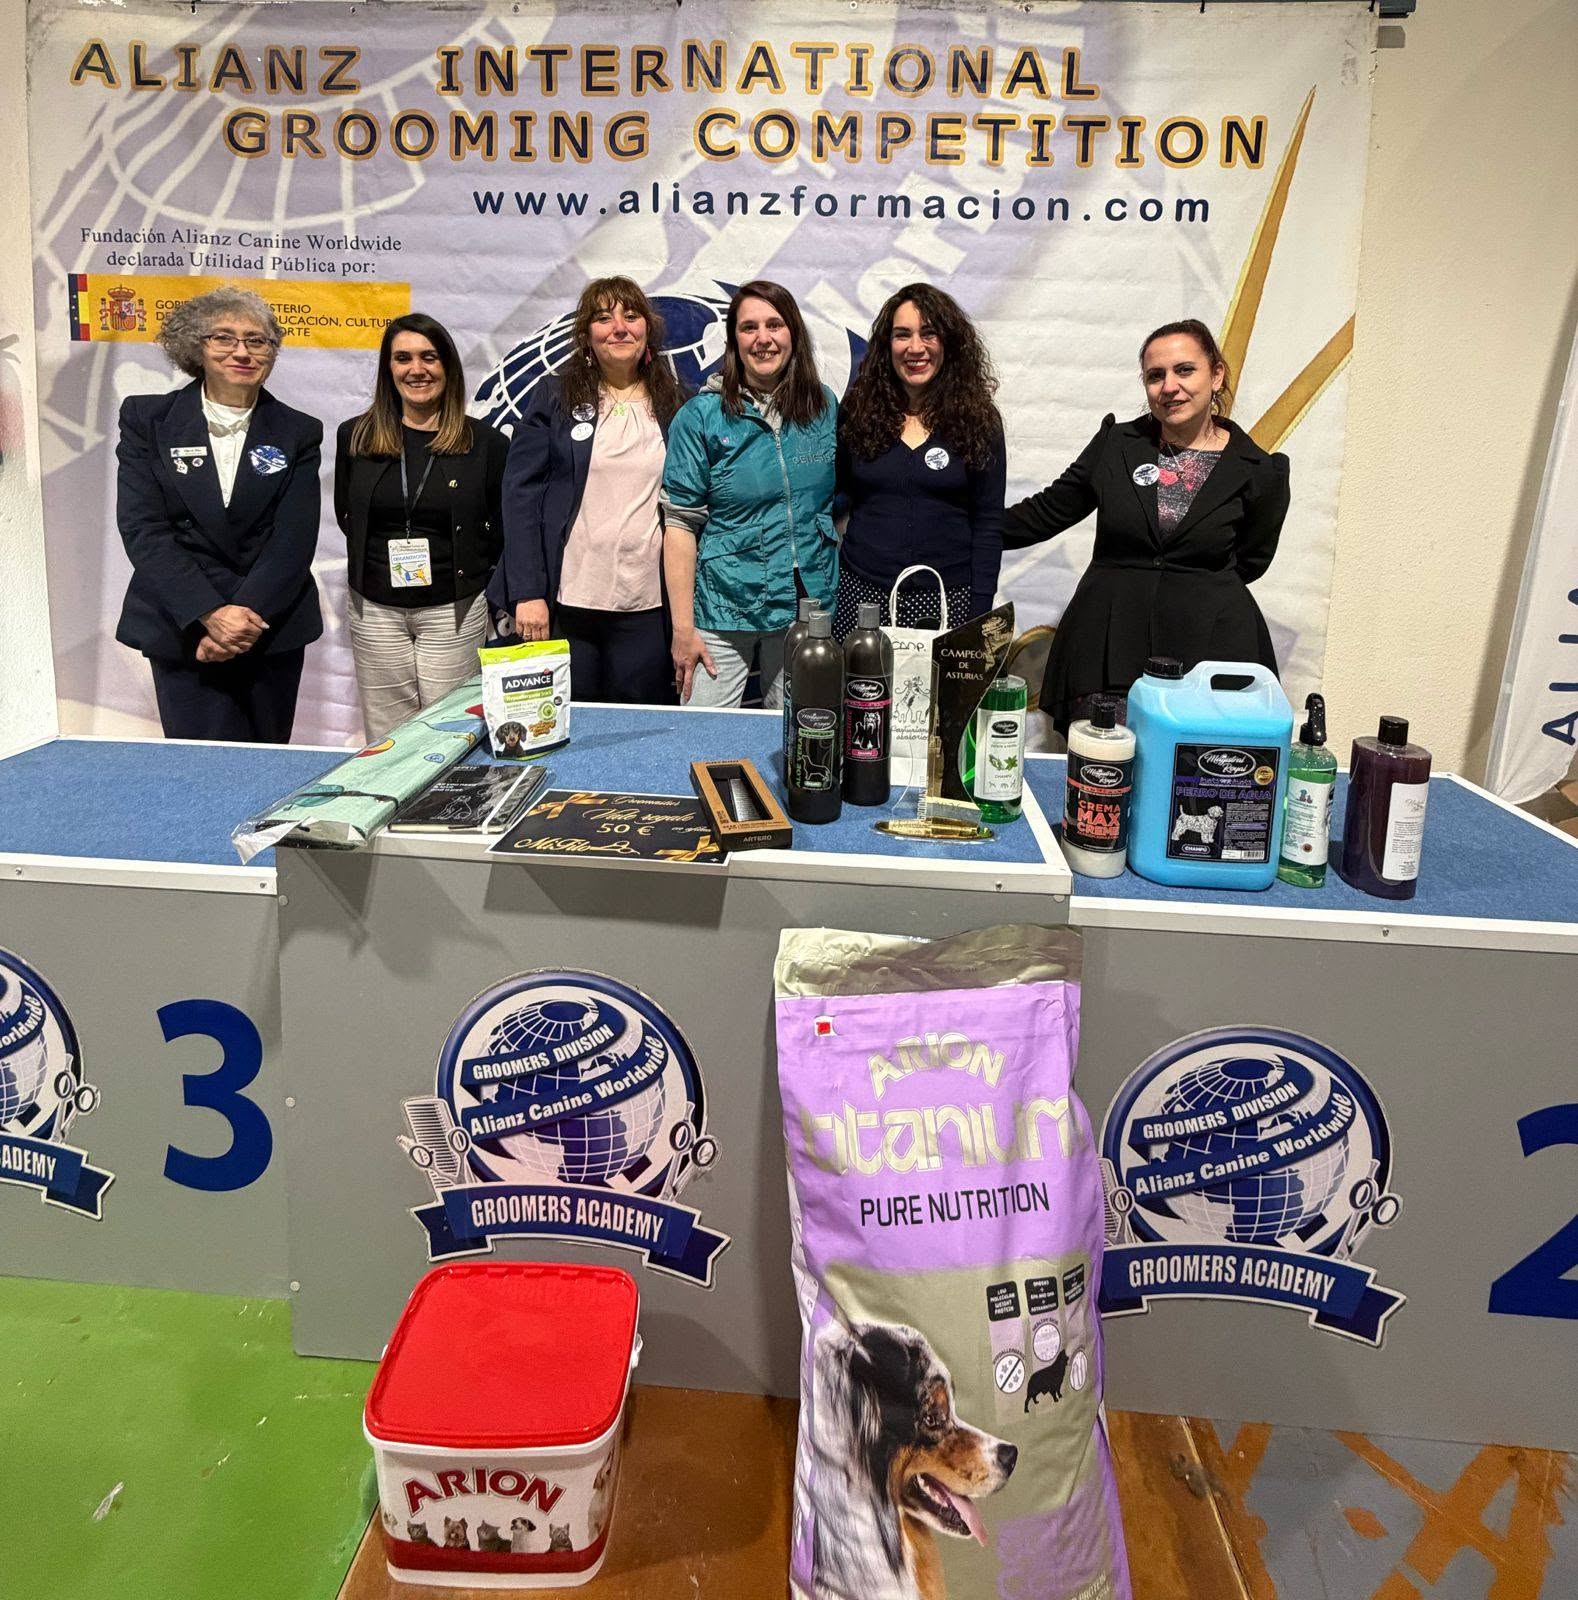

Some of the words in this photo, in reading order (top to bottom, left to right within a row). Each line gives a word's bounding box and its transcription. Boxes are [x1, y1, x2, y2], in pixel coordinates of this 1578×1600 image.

[71, 38, 361, 95] ALIANZ
[438, 39, 1100, 102] INTERNATIONAL
[223, 107, 650, 163] GROOMING
[692, 107, 1269, 169] COMPETITION
[472, 183, 1211, 224] www.alianzformacion.com
[81, 228, 166, 244] Fundación
[171, 229, 231, 247] Alianz
[238, 233, 301, 250] Canine
[305, 234, 402, 252] Worldwide
[106, 252, 185, 267] declarada
[190, 252, 265, 271] Utilidad
[271, 256, 337, 274] Pública
[341, 261, 377, 276] por:
[266, 303, 311, 314] STERIO
[345, 317, 392, 328] CULTUR
[505, 675, 551, 690] ADVANCE
[945, 671, 984, 681] ASTURIAS
[958, 661, 970, 669] DE
[1222, 762, 1248, 775] Royal
[1079, 799, 1121, 812] CREMA
[1176, 786, 1218, 798] PERRO
[1219, 788, 1237, 800] DE
[1238, 789, 1272, 800] AGUA
[596, 822, 630, 834] 50
[637, 825, 655, 836] €
[1077, 807, 1121, 827] MAX
[743, 834, 772, 843] ARTERO
[0, 994, 43, 1049] orldwide
[472, 1051, 551, 1081] GROOMERS
[553, 1022, 616, 1062] DIVISION
[867, 1032, 1007, 1101] ARION
[156, 998, 273, 1192] 3
[470, 1111, 527, 1138] Alianz
[528, 1092, 593, 1122] Canine
[594, 1034, 665, 1100] Worldwide
[1143, 1110, 1227, 1140] GROOMERS
[1231, 1081, 1300, 1121] DIVISION
[0, 1143, 57, 1182] ADEMY
[1135, 1169, 1195, 1196] Alianz
[1200, 1151, 1270, 1180] Canine
[1272, 1092, 1352, 1158] Worldwide
[471, 1195, 571, 1228] GROOMERS
[576, 1196, 664, 1243] ACADEMY
[860, 1194, 923, 1227] PURE
[928, 1182, 1050, 1224] NUTRITION
[1487, 1103, 1578, 1320] 2
[1128, 1254, 1237, 1289] GROOMERS
[1240, 1256, 1336, 1303] ACADEMY
[995, 1305, 1014, 1315] PROTEIN
[402, 1466, 566, 1516] ARION
